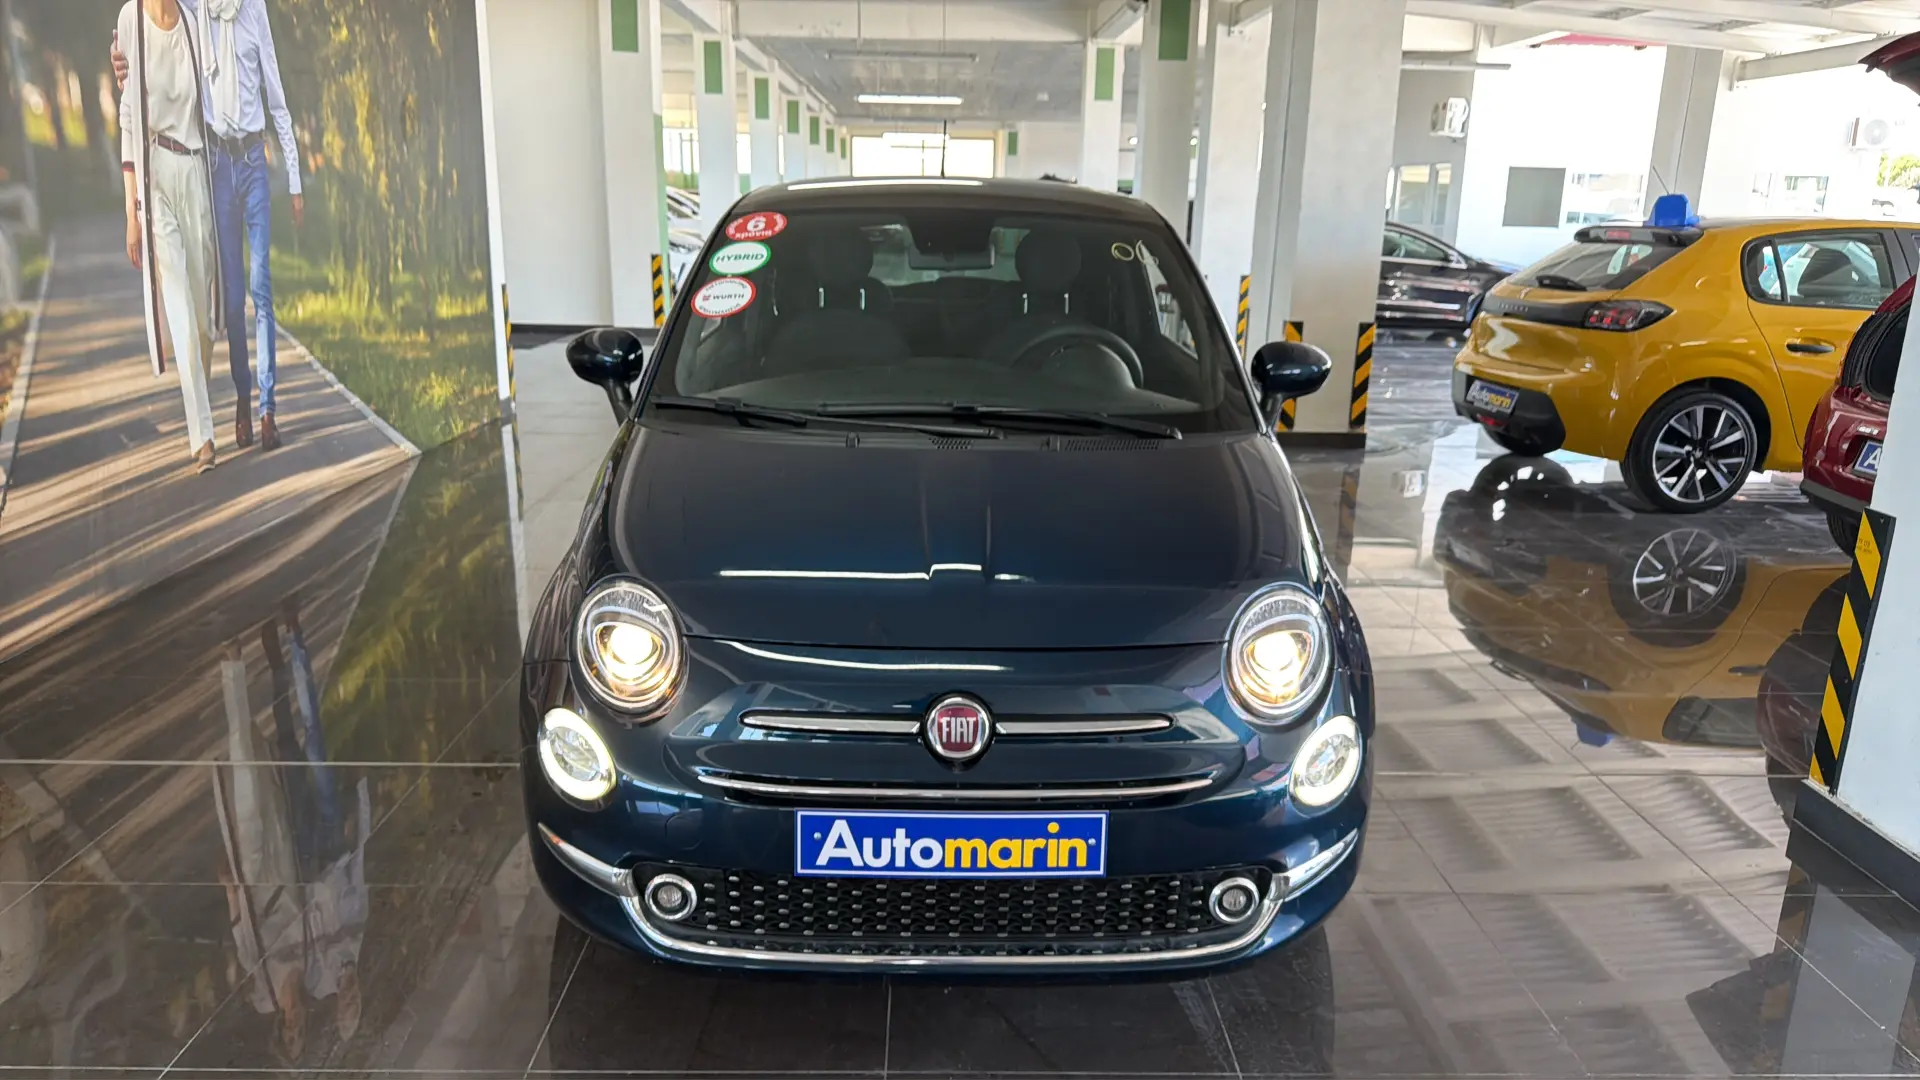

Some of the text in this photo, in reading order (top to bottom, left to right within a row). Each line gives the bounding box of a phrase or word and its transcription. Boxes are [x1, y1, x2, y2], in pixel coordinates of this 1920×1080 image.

[747, 215, 766, 231] 6
[715, 252, 764, 263] HYBRID
[939, 716, 978, 744] FIAT
[815, 819, 1087, 869] Automarin
